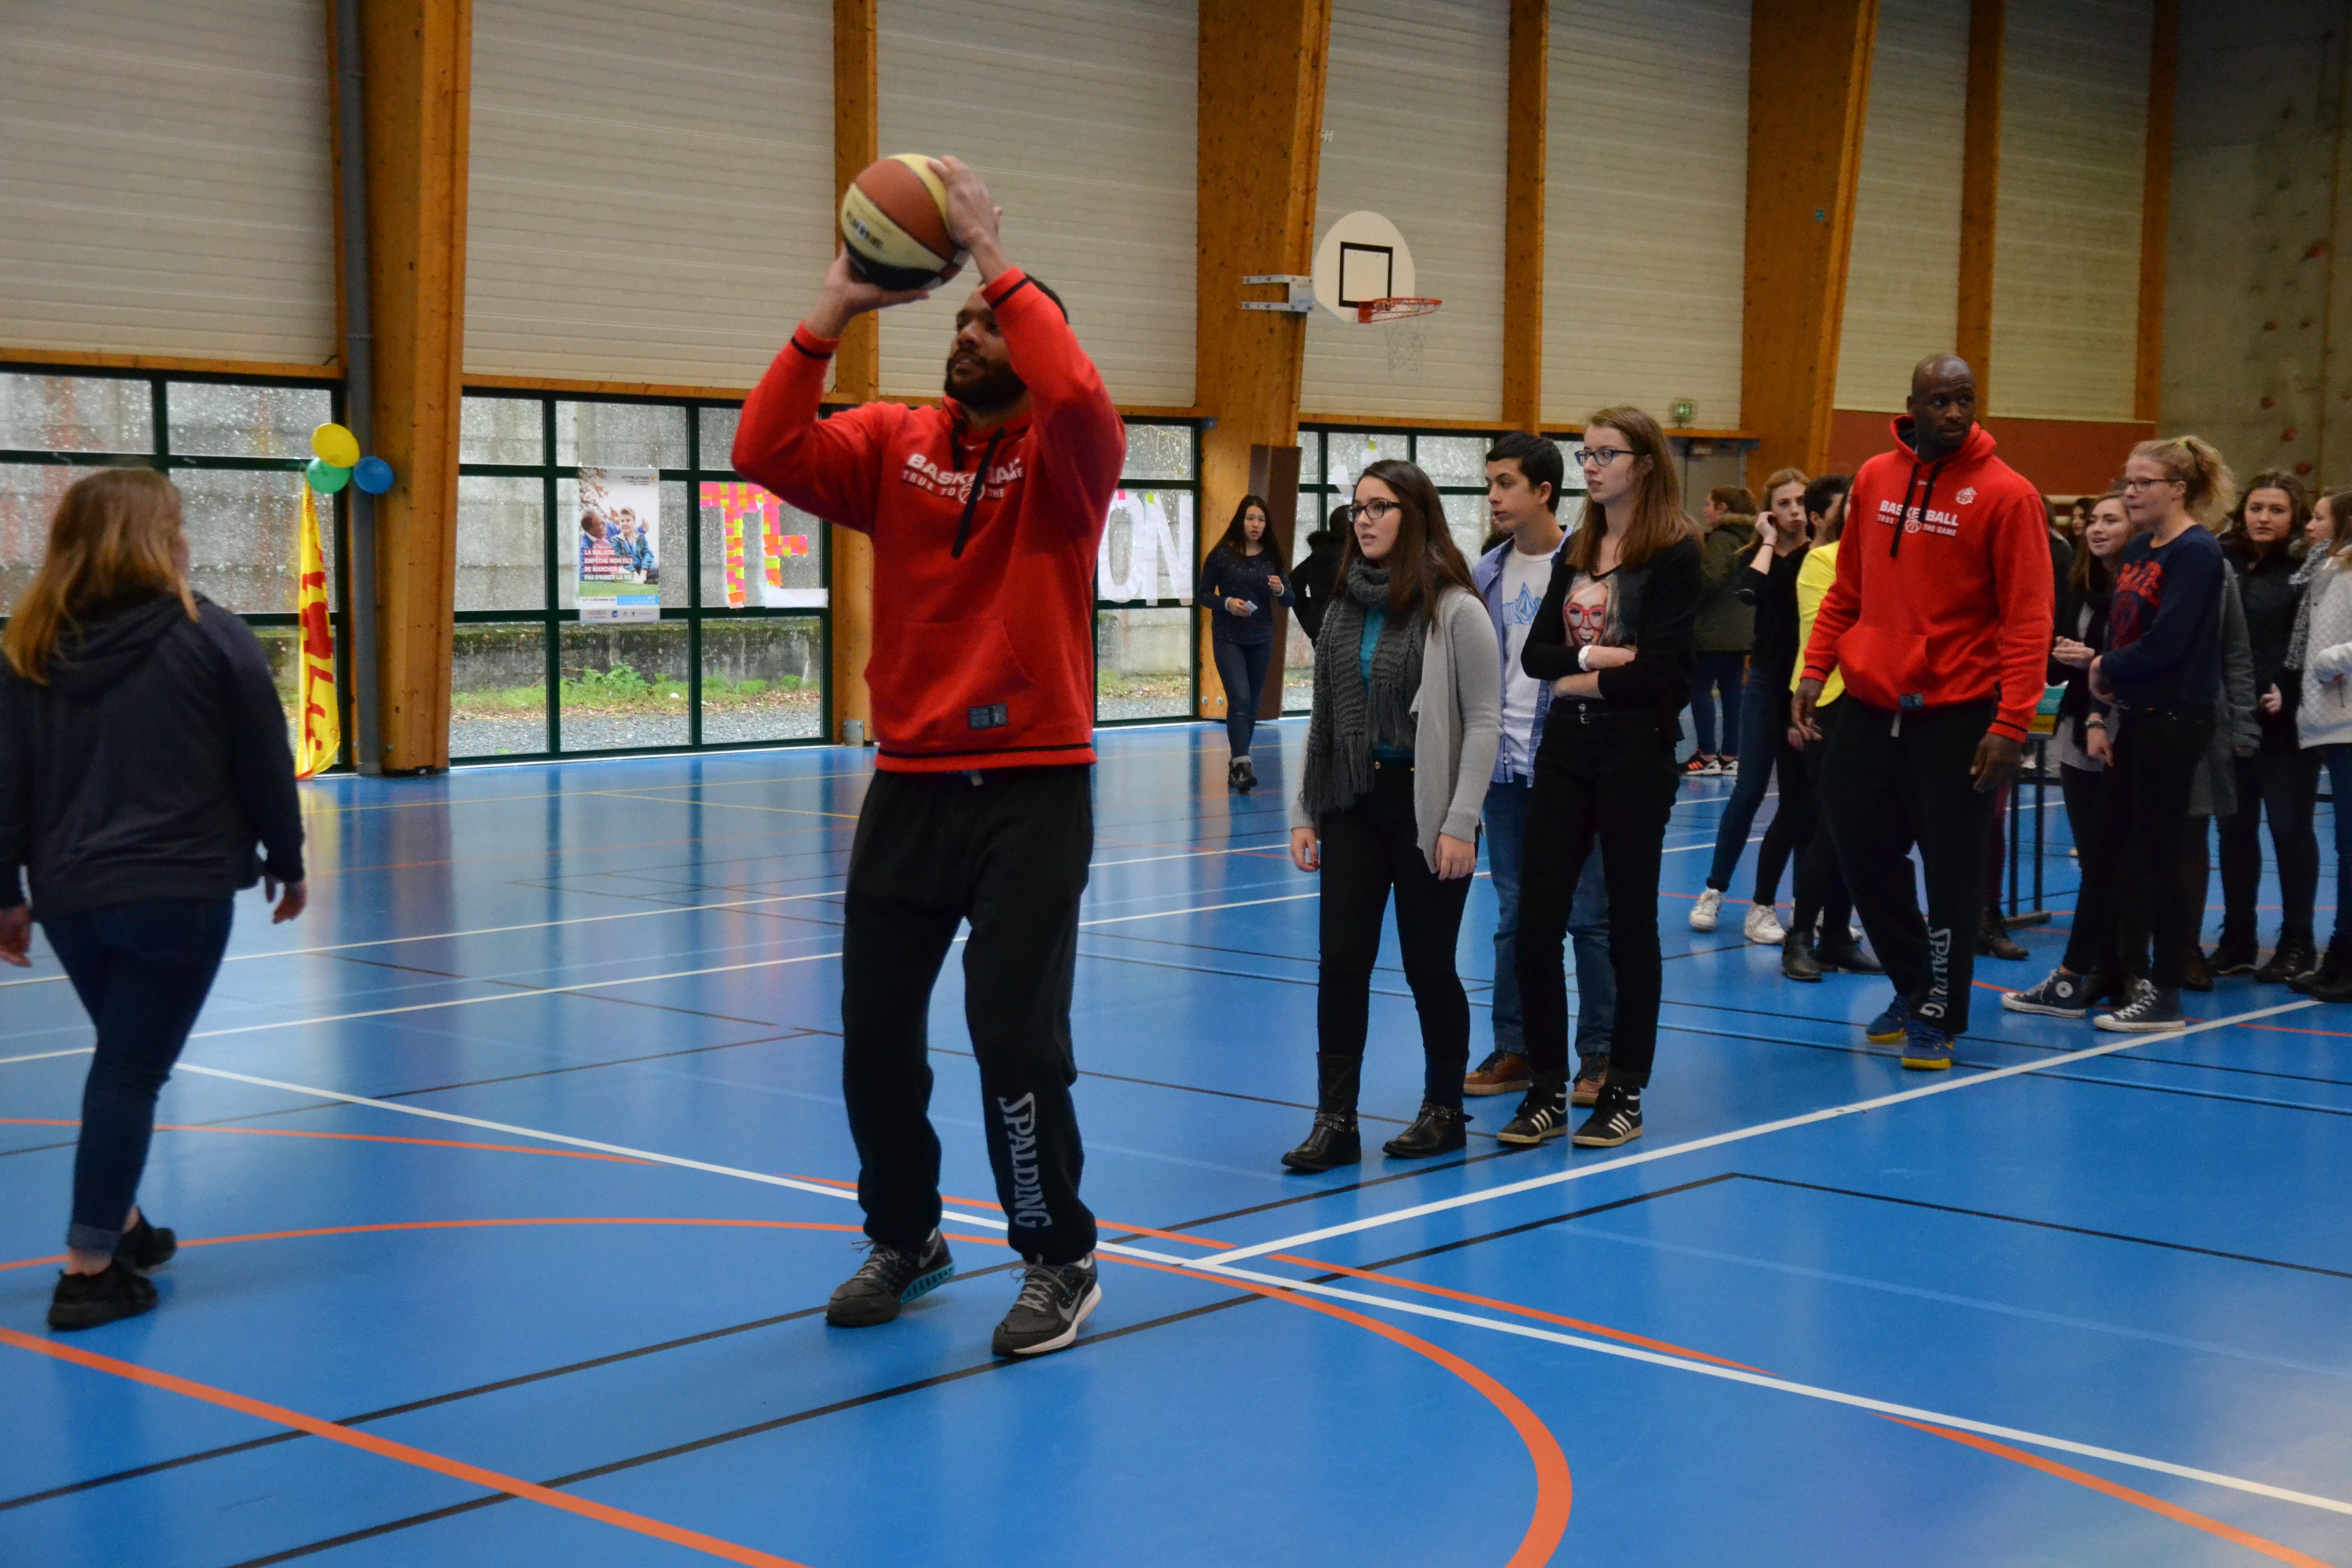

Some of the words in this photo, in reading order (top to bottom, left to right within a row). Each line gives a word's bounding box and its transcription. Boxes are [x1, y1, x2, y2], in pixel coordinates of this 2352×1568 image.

[907, 453, 1021, 484] BASKBA
[902, 470, 935, 491] TRUE
[941, 487, 956, 497] TO
[1879, 500, 1959, 526] BASKEBALL
[1923, 524, 1935, 532] THE
[1937, 526, 1957, 536] GAME
[1919, 928, 1951, 1018] SPALDING
[998, 1092, 1053, 1228] SPALDING
